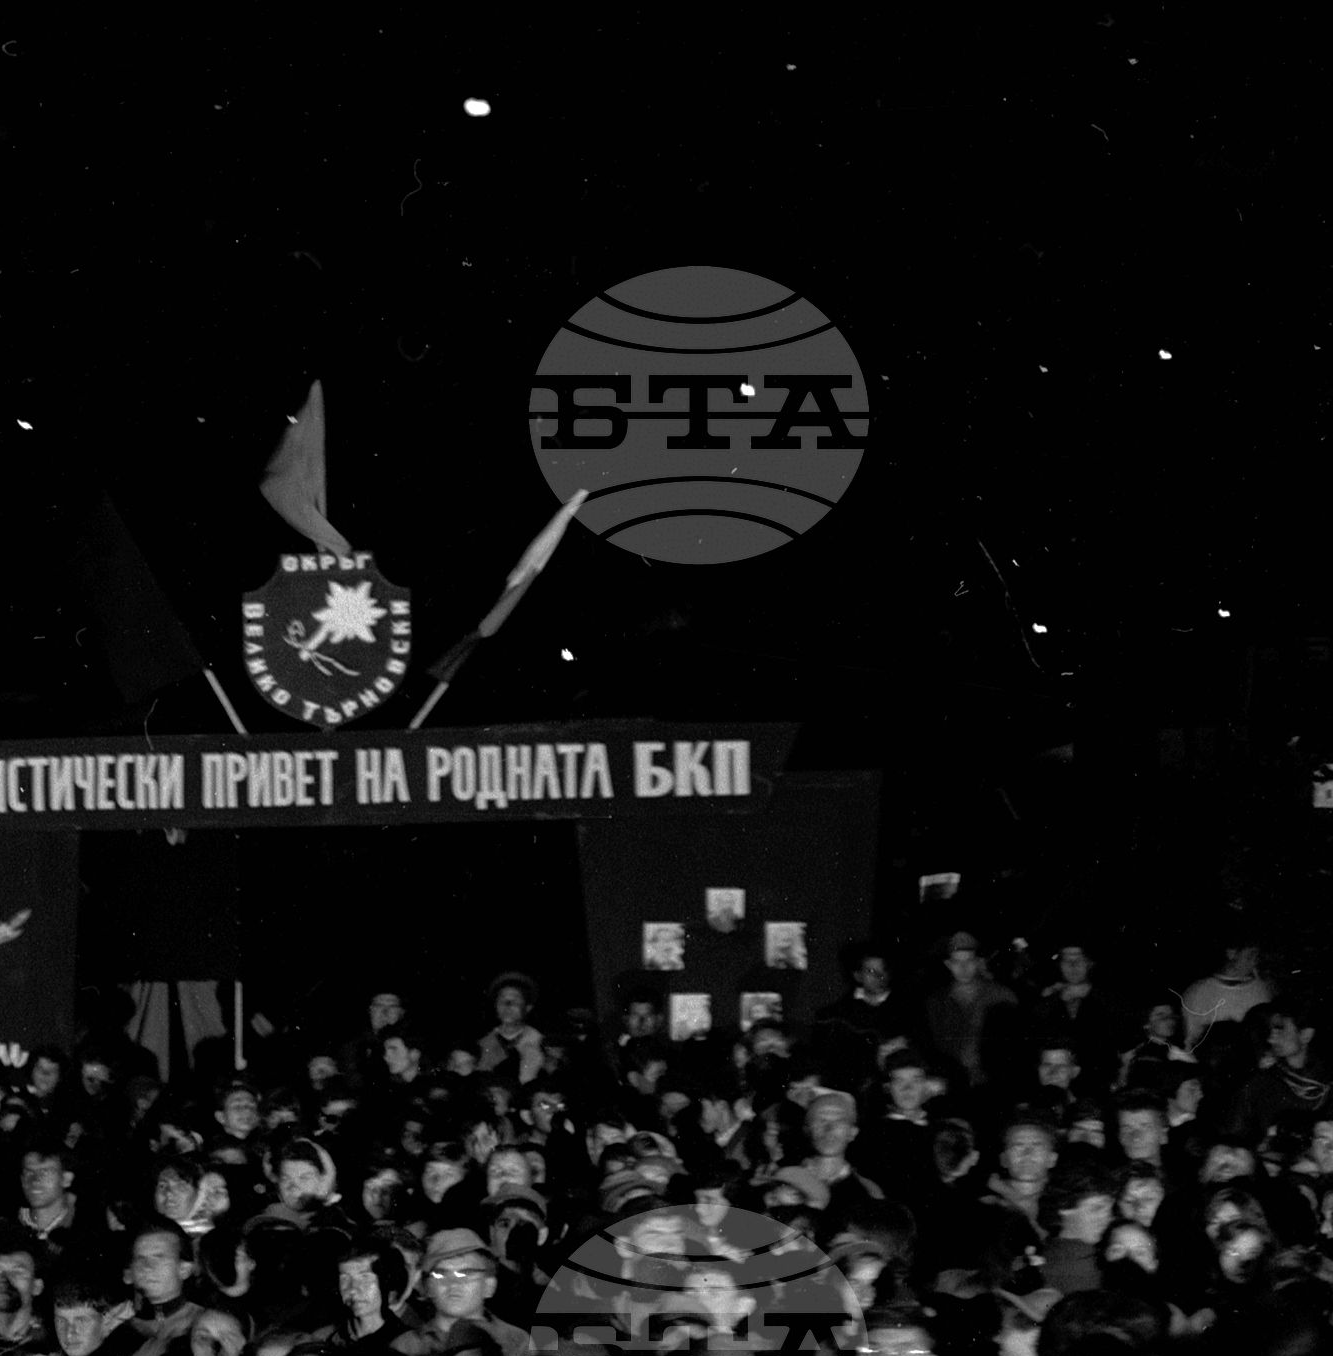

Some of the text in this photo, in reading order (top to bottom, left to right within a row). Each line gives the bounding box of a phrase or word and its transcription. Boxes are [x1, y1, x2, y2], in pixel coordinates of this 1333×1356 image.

[281, 552, 373, 573] ОКРЪГ
[200, 749, 340, 808] ПРИВЕТ
[355, 748, 411, 804] НА
[425, 742, 615, 809] РОДНАТА
[632, 740, 753, 798] БКП
